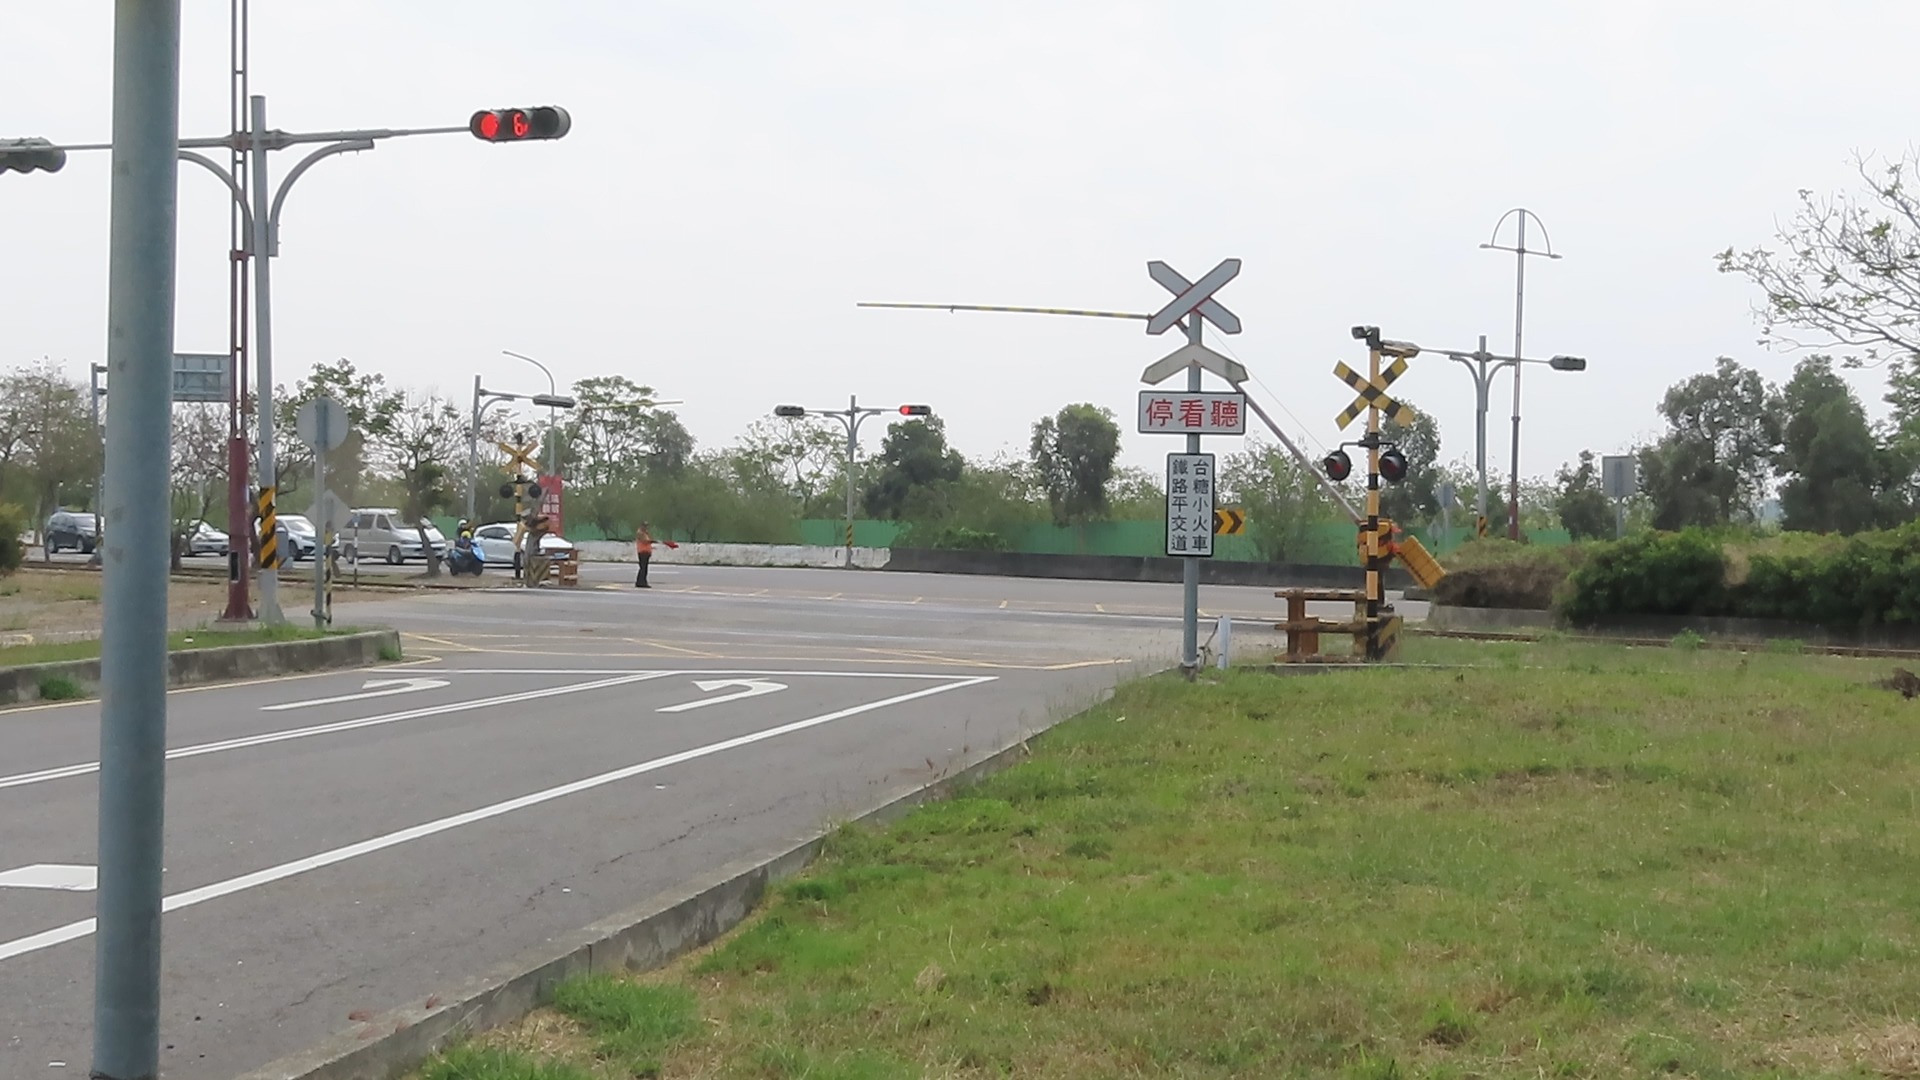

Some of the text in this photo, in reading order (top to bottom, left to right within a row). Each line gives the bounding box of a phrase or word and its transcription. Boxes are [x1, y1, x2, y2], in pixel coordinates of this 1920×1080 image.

[513, 112, 529, 137] 6
[1145, 398, 1239, 428] 停看聽
[1171, 459, 1189, 552] 鐵路平交道
[1191, 460, 1209, 552] 台糖小火車
